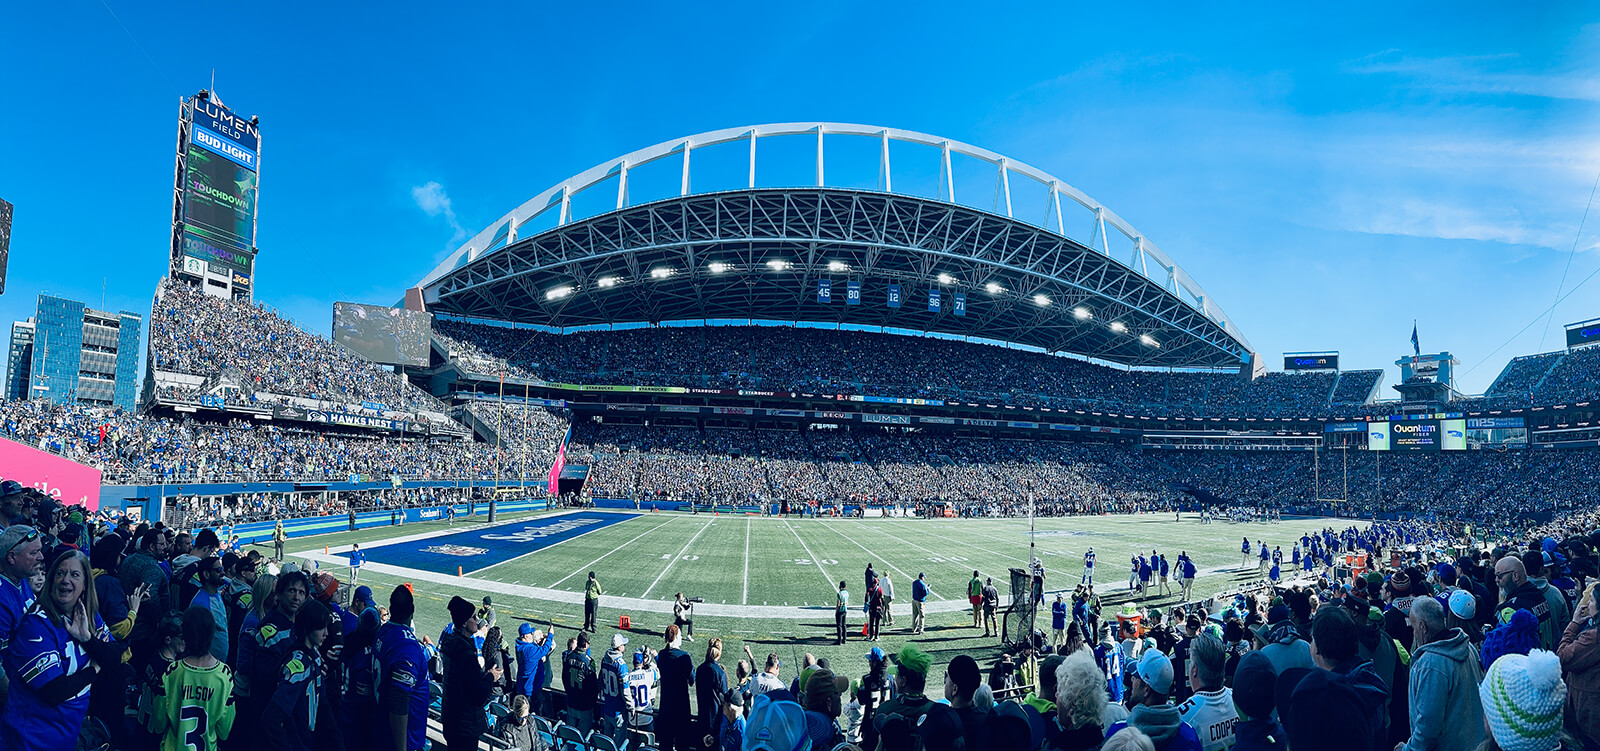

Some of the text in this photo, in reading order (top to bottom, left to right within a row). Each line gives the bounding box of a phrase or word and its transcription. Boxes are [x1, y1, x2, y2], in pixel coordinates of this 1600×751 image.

[194, 98, 258, 139] LUMEN
[212, 120, 241, 140] FIELD
[197, 130, 253, 165] BUD LIGHT
[193, 180, 249, 210] TOUCHDOWN
[185, 237, 250, 266] TOUCHDOWN
[818, 287, 831, 298] 45
[848, 290, 859, 299] 80
[889, 293, 899, 303] 12
[929, 298, 940, 307] 96
[955, 301, 965, 310] 71
[1294, 358, 1327, 366] Quantum
[330, 413, 393, 428] HAWKS NEST
[865, 415, 908, 423] LUMEN
[1393, 424, 1436, 433] Quantum
[621, 617, 629, 628] 10
[180, 705, 209, 751] 3
